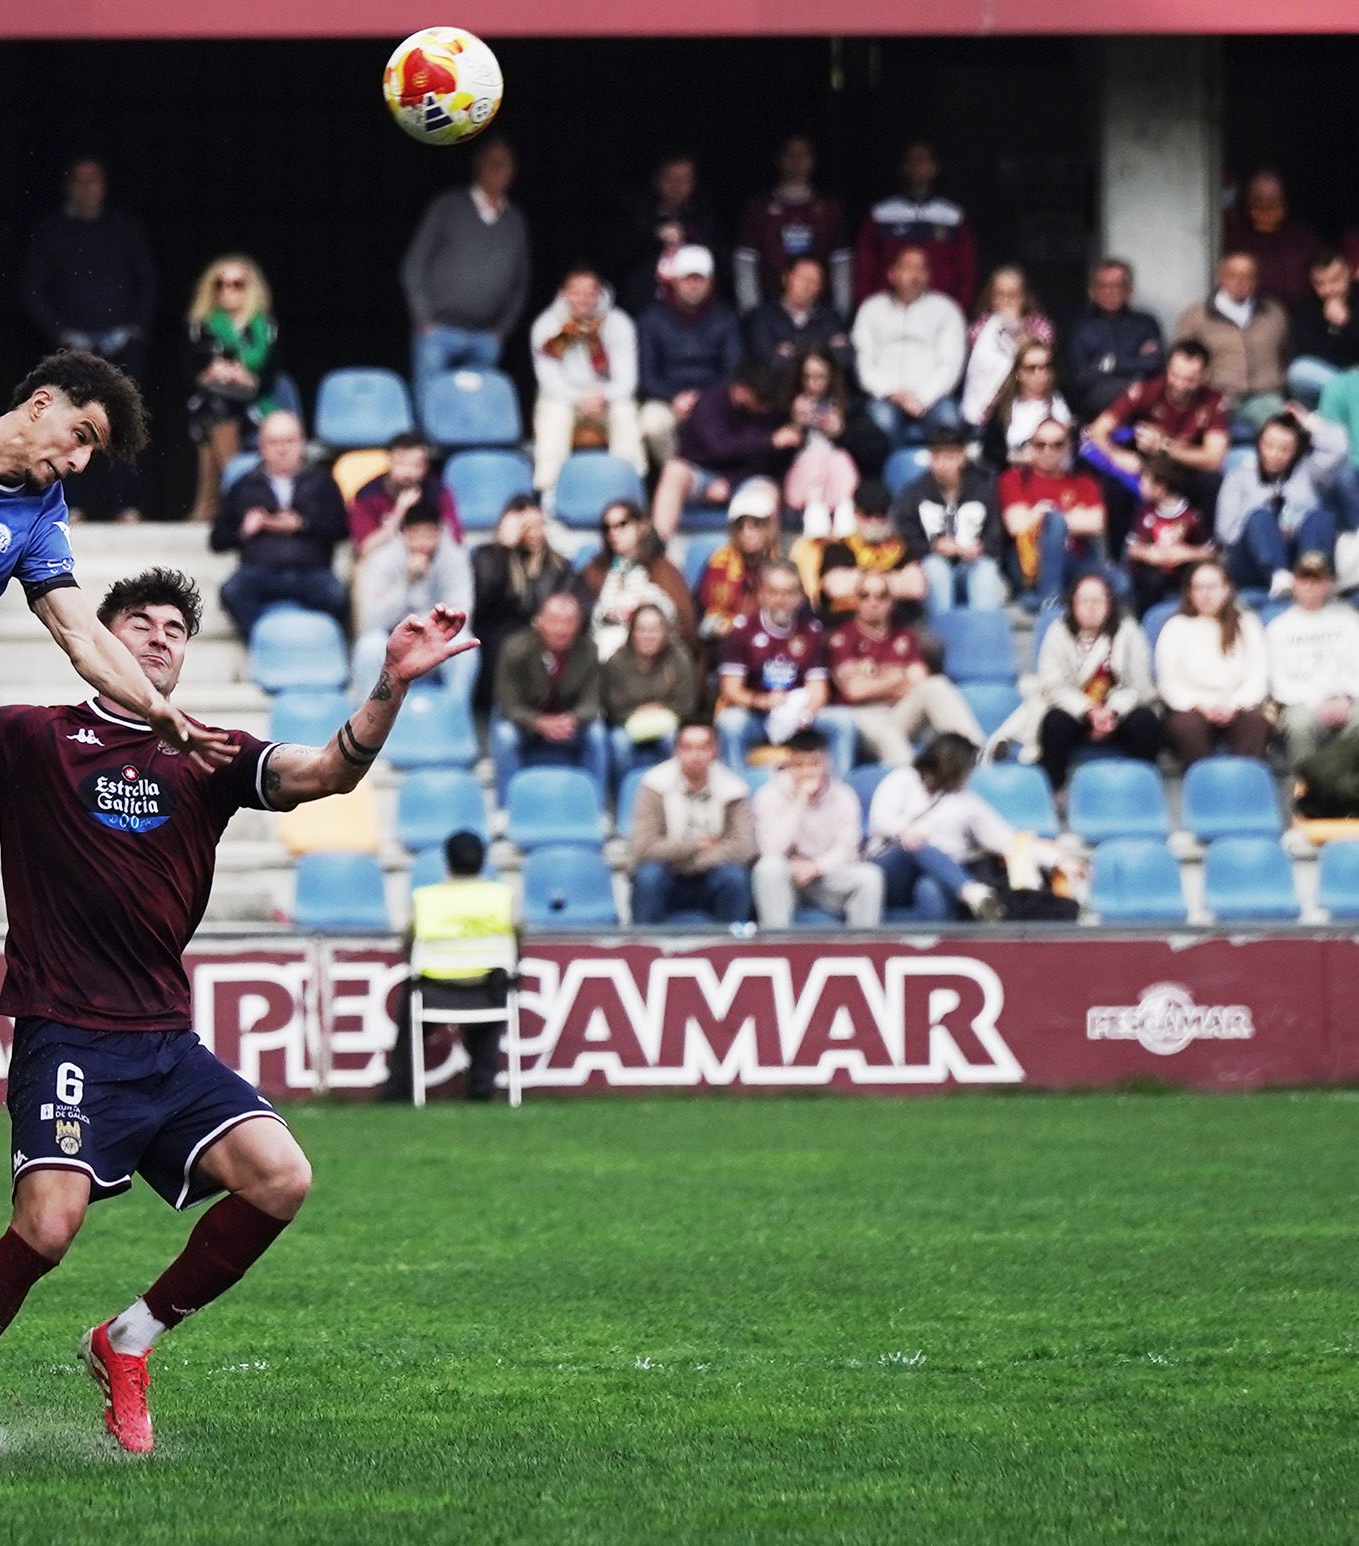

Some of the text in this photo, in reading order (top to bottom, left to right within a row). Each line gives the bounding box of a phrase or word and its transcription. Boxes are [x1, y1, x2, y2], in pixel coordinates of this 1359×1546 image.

[94, 776, 160, 797] Estrella
[97, 793, 159, 815] Galicia
[56, 1061, 85, 1106] 6
